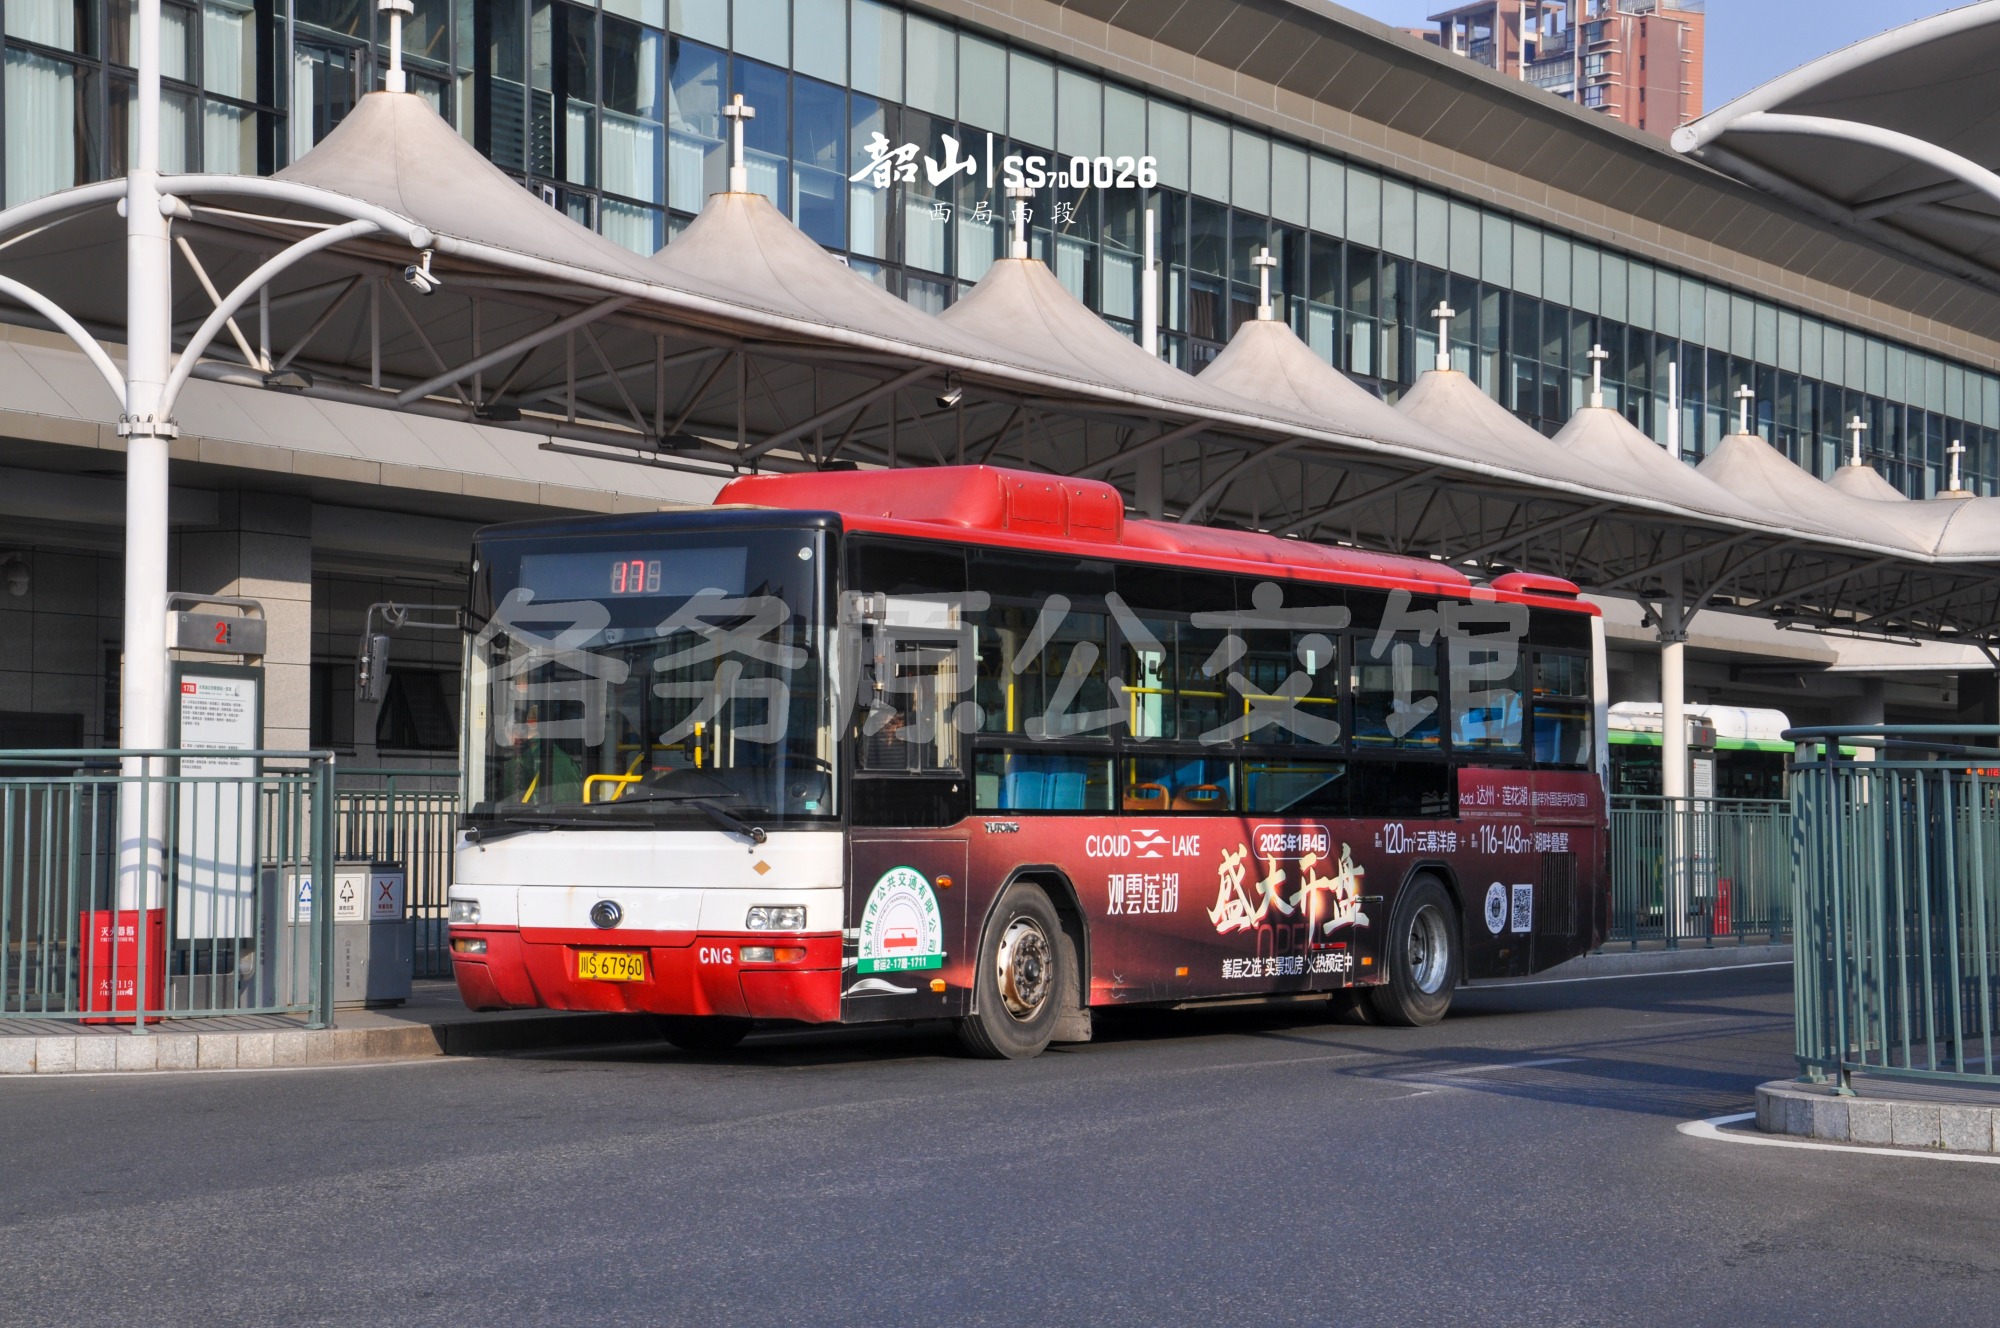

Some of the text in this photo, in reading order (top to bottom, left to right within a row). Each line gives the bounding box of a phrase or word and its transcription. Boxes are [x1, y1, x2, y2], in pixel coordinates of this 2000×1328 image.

[620, 560, 645, 593] 17
[215, 621, 227, 644] 2
[984, 821, 1020, 834] YUTONG
[1085, 834, 1201, 858] CLOUD LAKE
[1260, 833, 1327, 852] 2025年1月4日
[1207, 842, 1370, 948] 盛大开盘
[863, 872, 937, 958] 达州市公共交通有限公司
[700, 947, 733, 965] CNG
